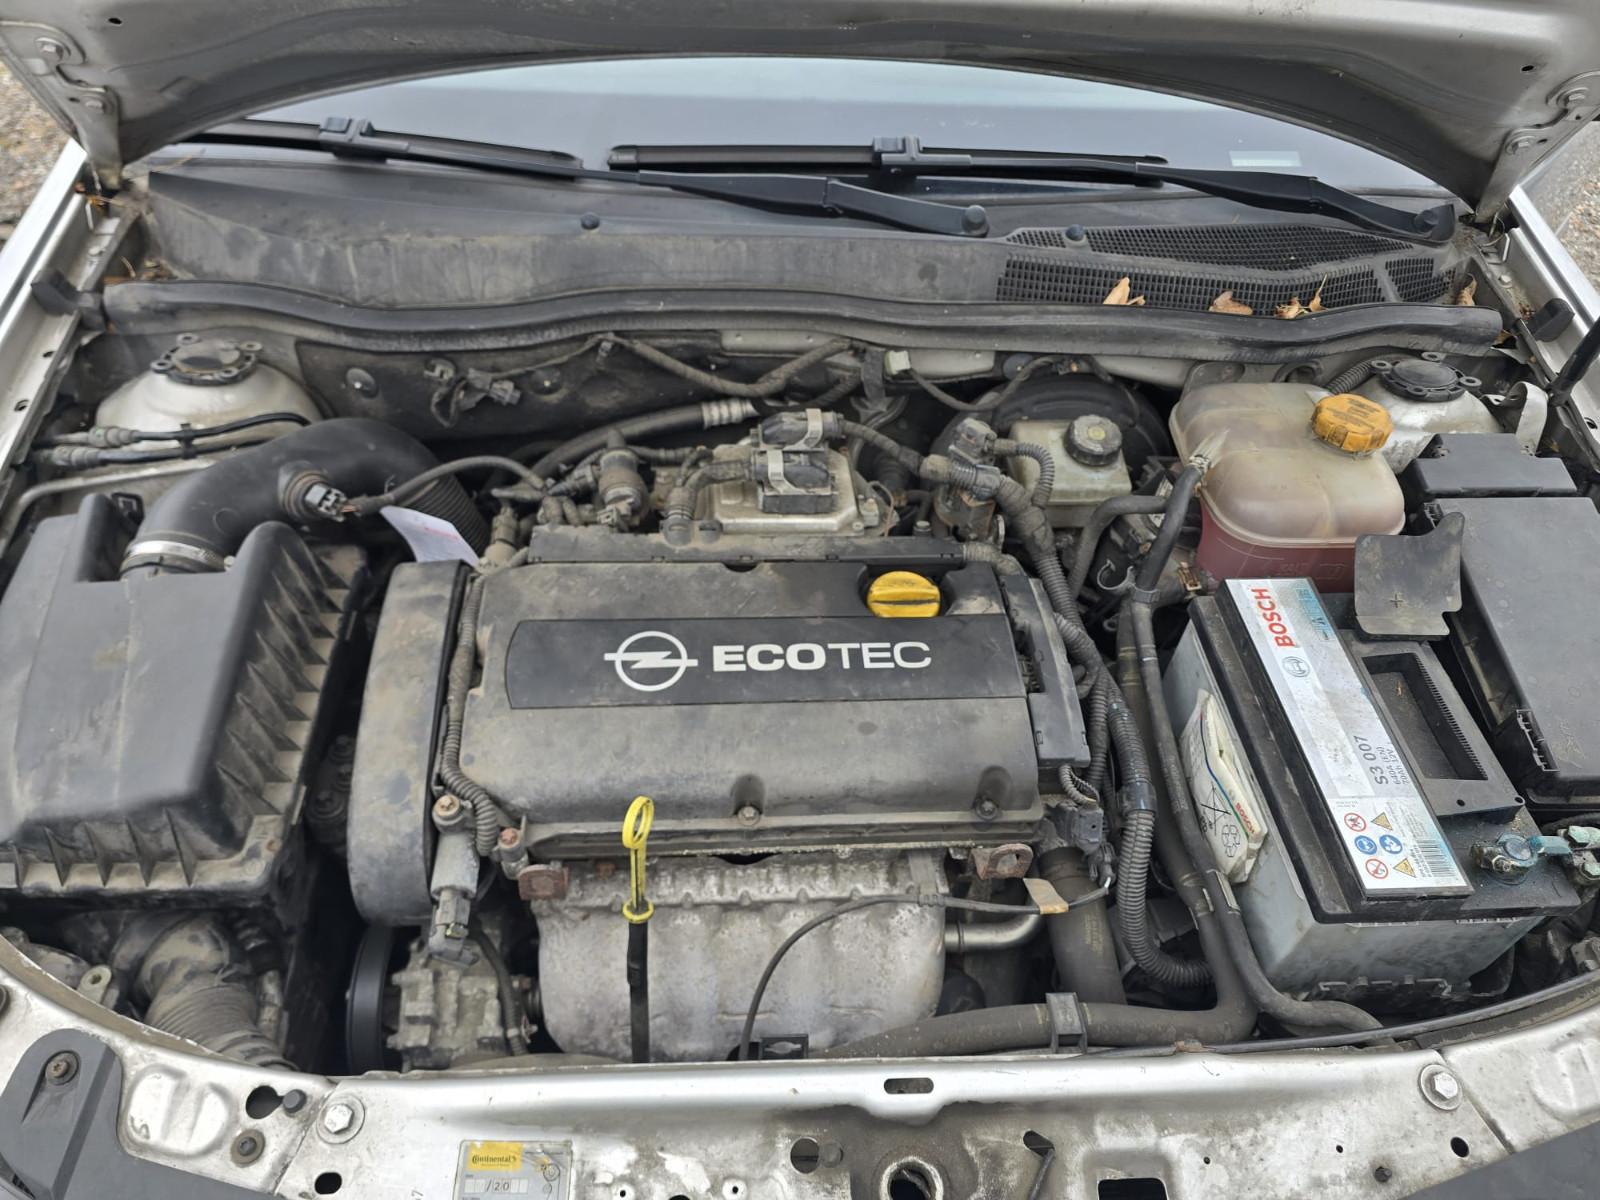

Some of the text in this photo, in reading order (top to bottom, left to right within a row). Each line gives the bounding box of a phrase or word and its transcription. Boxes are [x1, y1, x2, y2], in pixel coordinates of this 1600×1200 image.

[1251, 589, 1295, 646] BOSCH
[713, 641, 932, 672] ECOTEC
[1353, 735, 1389, 785] S3 007
[1235, 803, 1255, 834] BOSCH
